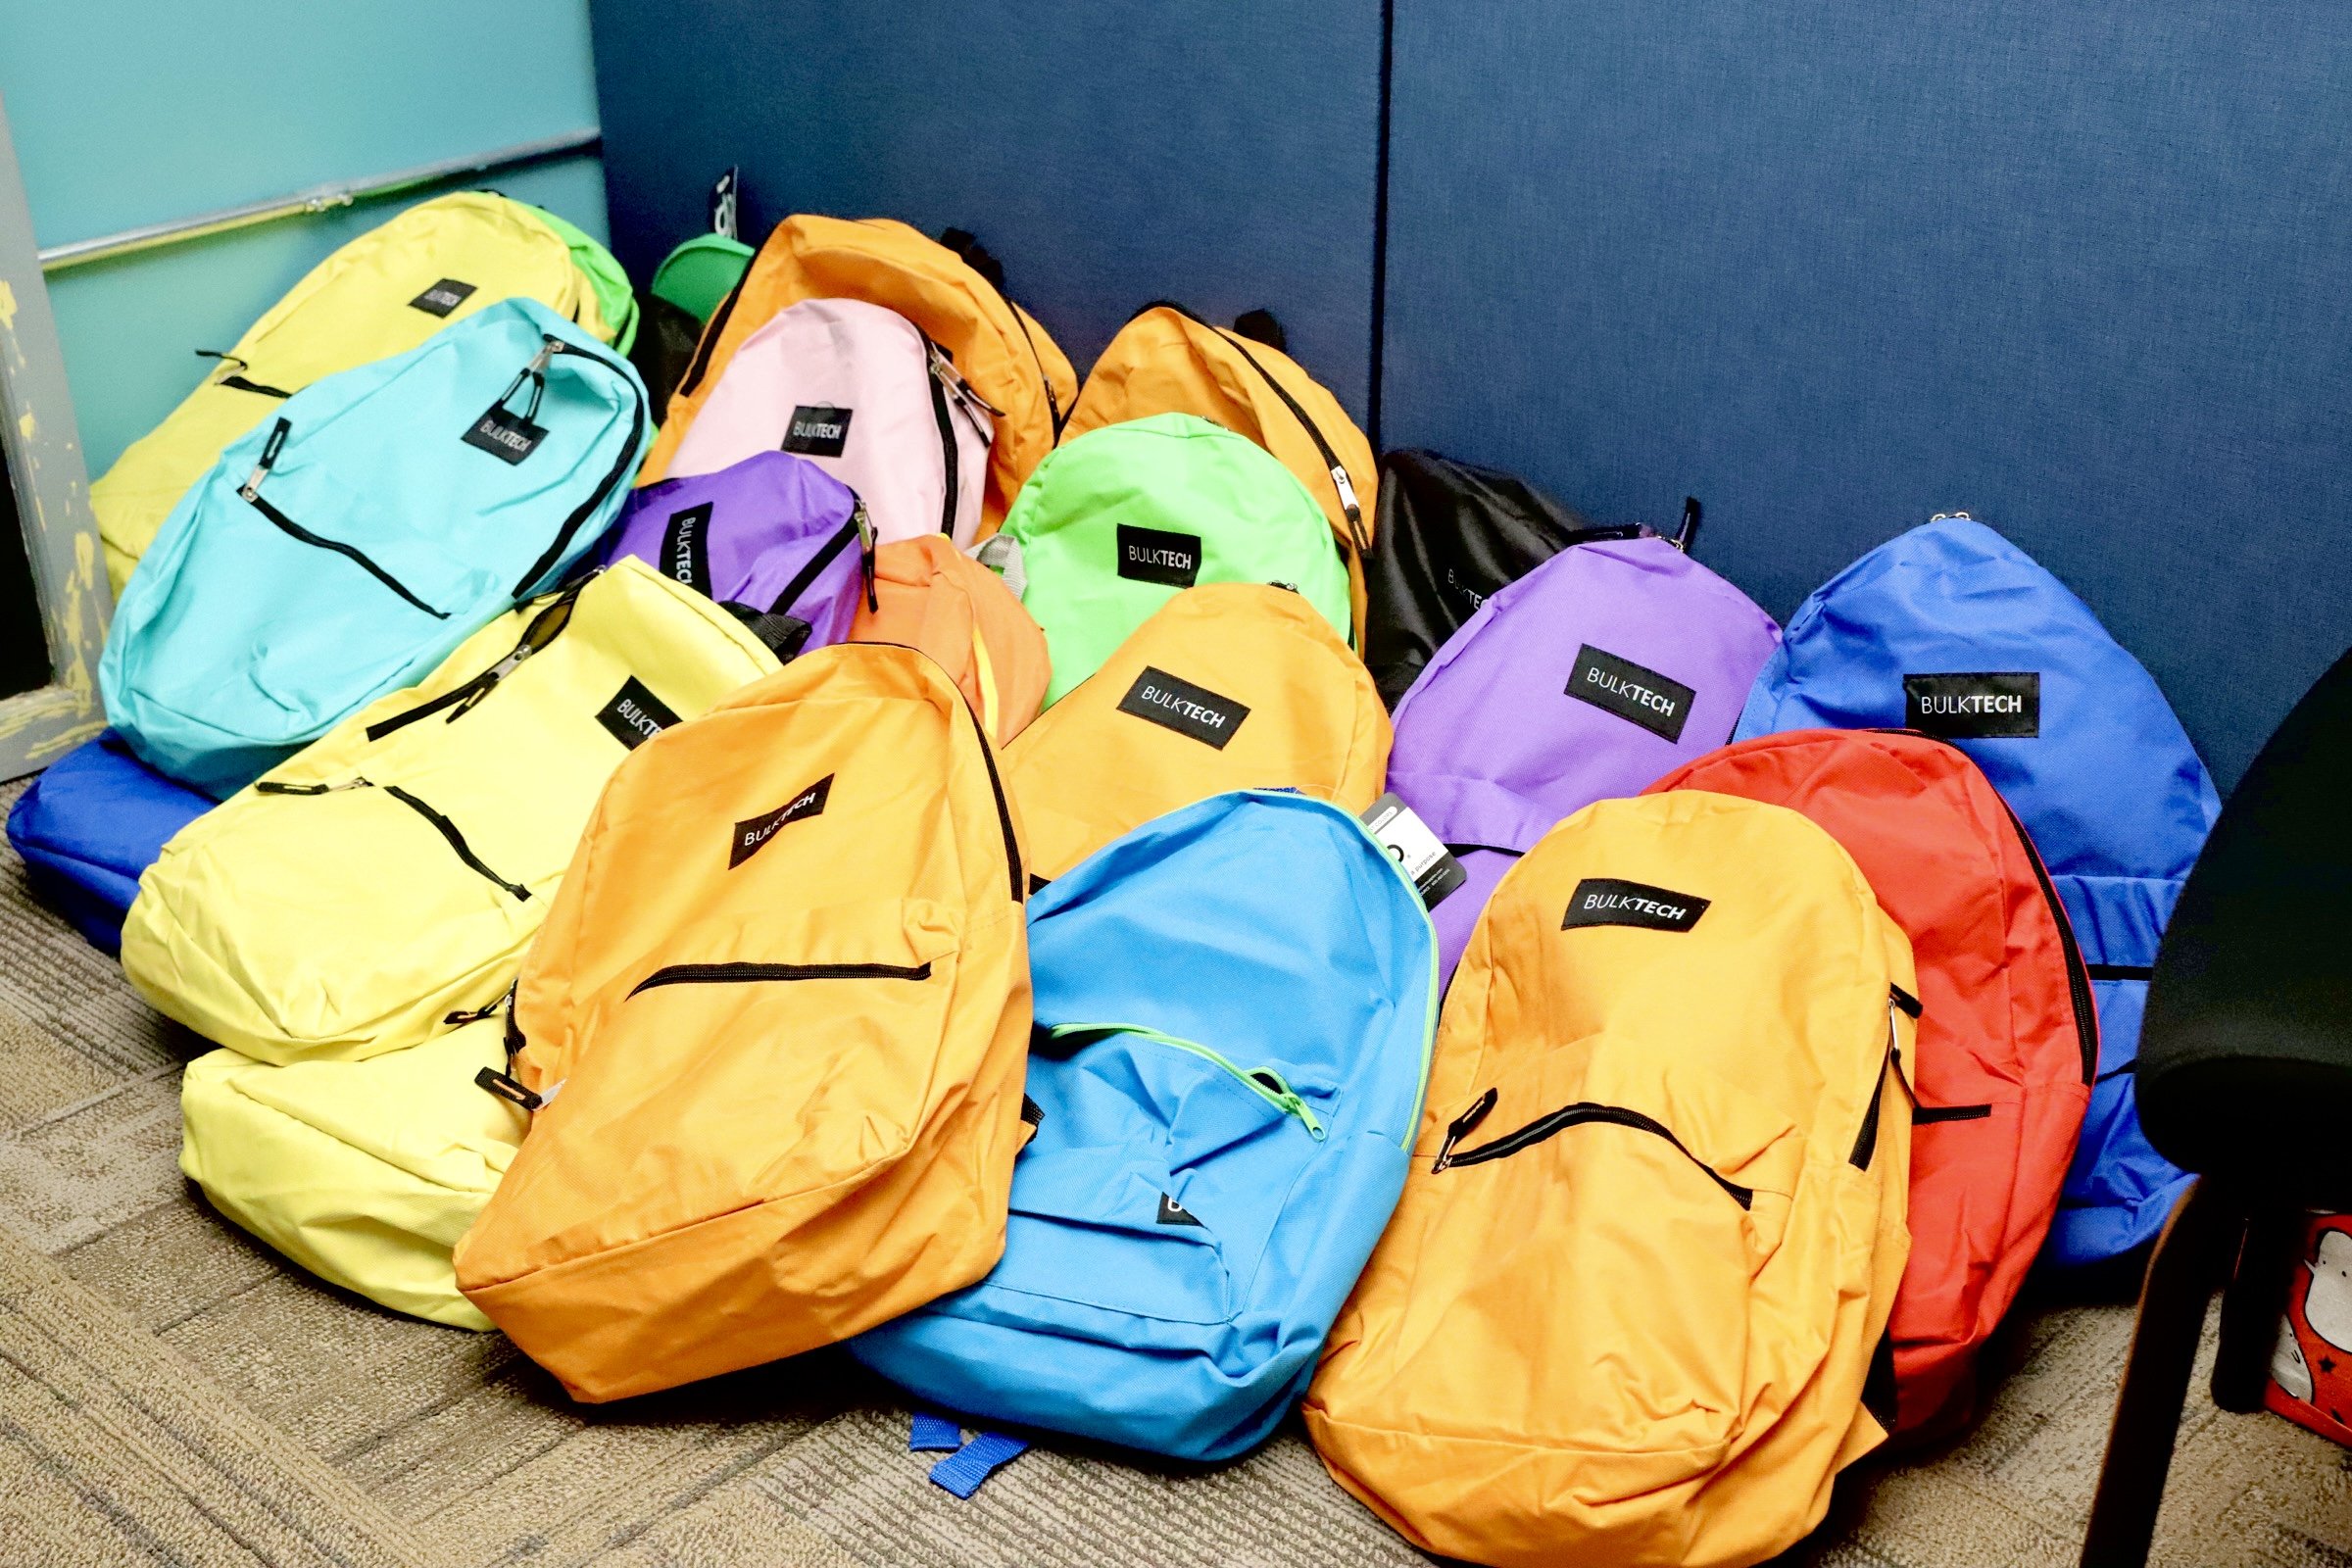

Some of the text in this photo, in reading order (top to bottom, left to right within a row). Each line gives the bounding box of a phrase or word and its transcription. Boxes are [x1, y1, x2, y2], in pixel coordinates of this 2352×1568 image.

[480, 419, 532, 452] BULKTECH
[793, 421, 842, 439] BULKTECH
[1129, 547, 1192, 569] BULKTECH
[1587, 667, 1676, 717] BULKTECH
[1921, 695, 2022, 713] BULKTECH
[616, 699, 663, 738] BULKTE
[1142, 686, 1226, 729] BULKTECH
[745, 792, 815, 846] BULKTECH
[1415, 851, 1437, 872] purpose
[1583, 894, 1687, 920] BULKTECH
